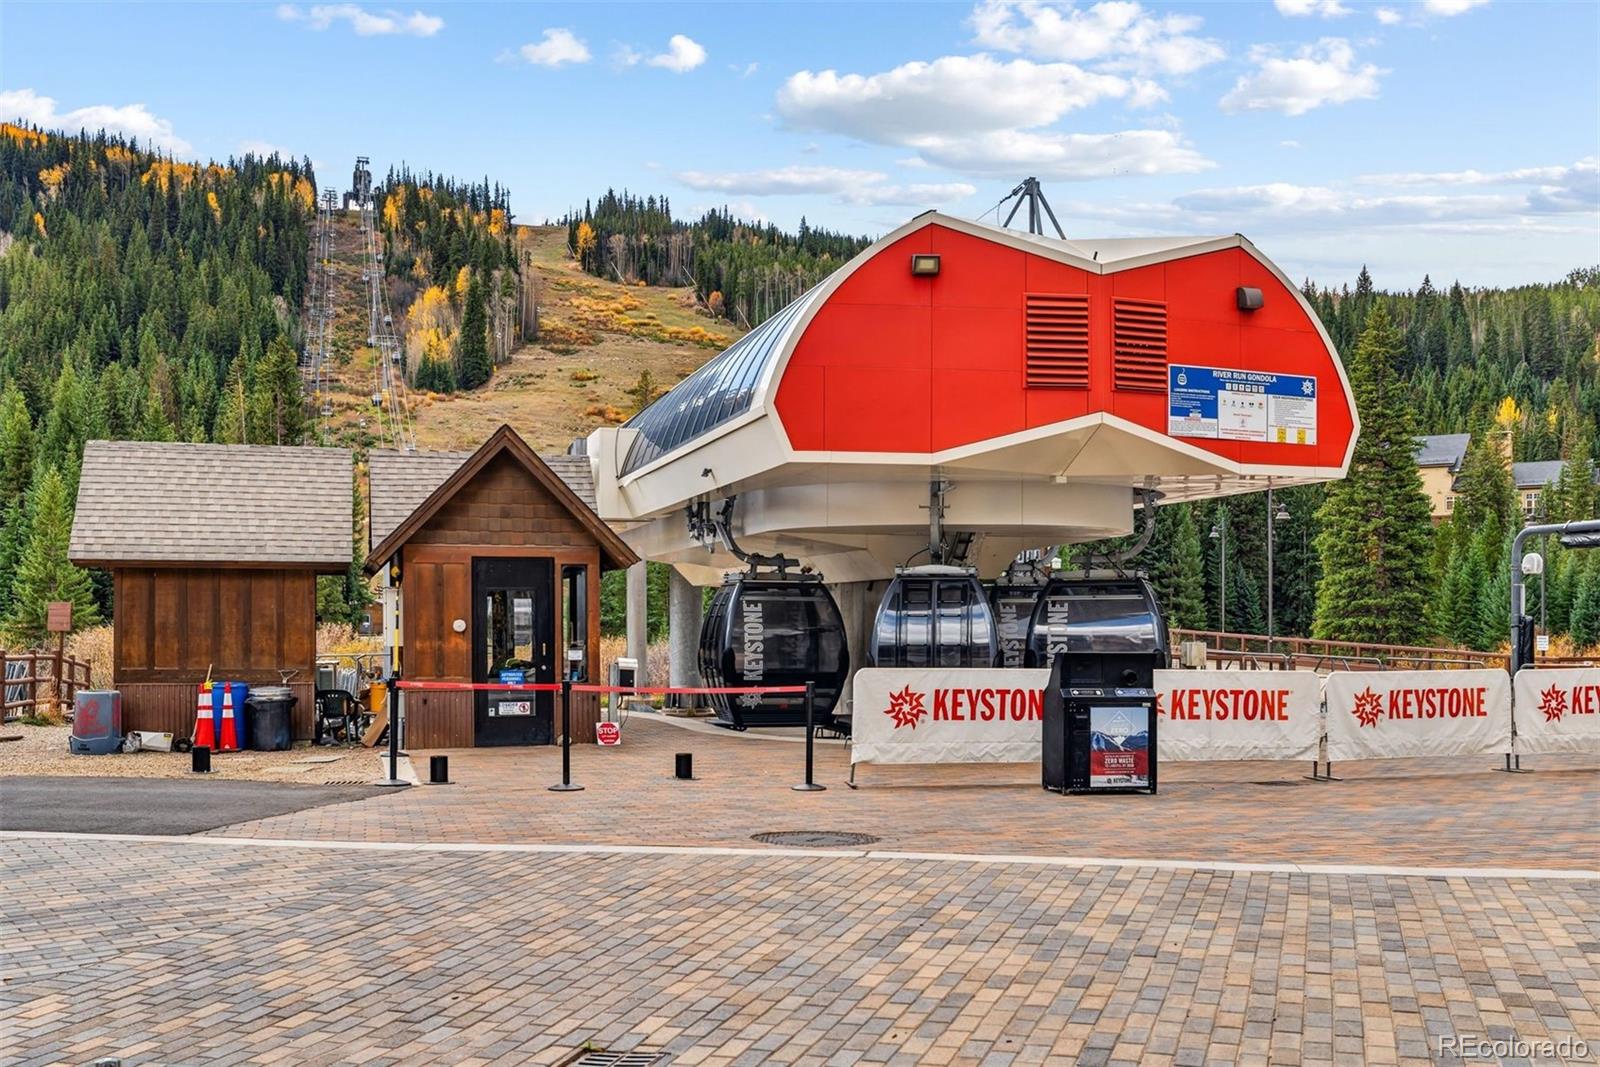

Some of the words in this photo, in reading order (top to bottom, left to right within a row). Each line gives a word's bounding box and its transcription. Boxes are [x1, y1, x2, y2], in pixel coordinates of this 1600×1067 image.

[1212, 370, 1232, 379] RIVER
[1233, 372, 1246, 380] RUN
[1247, 373, 1277, 383] GONDOLA
[743, 600, 764, 681] KEYSTONE
[999, 602, 1020, 668] EYSTONE
[932, 688, 1044, 722] KEYSTON
[1170, 689, 1290, 721] KEYSTONE
[1388, 687, 1488, 720] KEYSTONE
[598, 727, 618, 735] STOP
